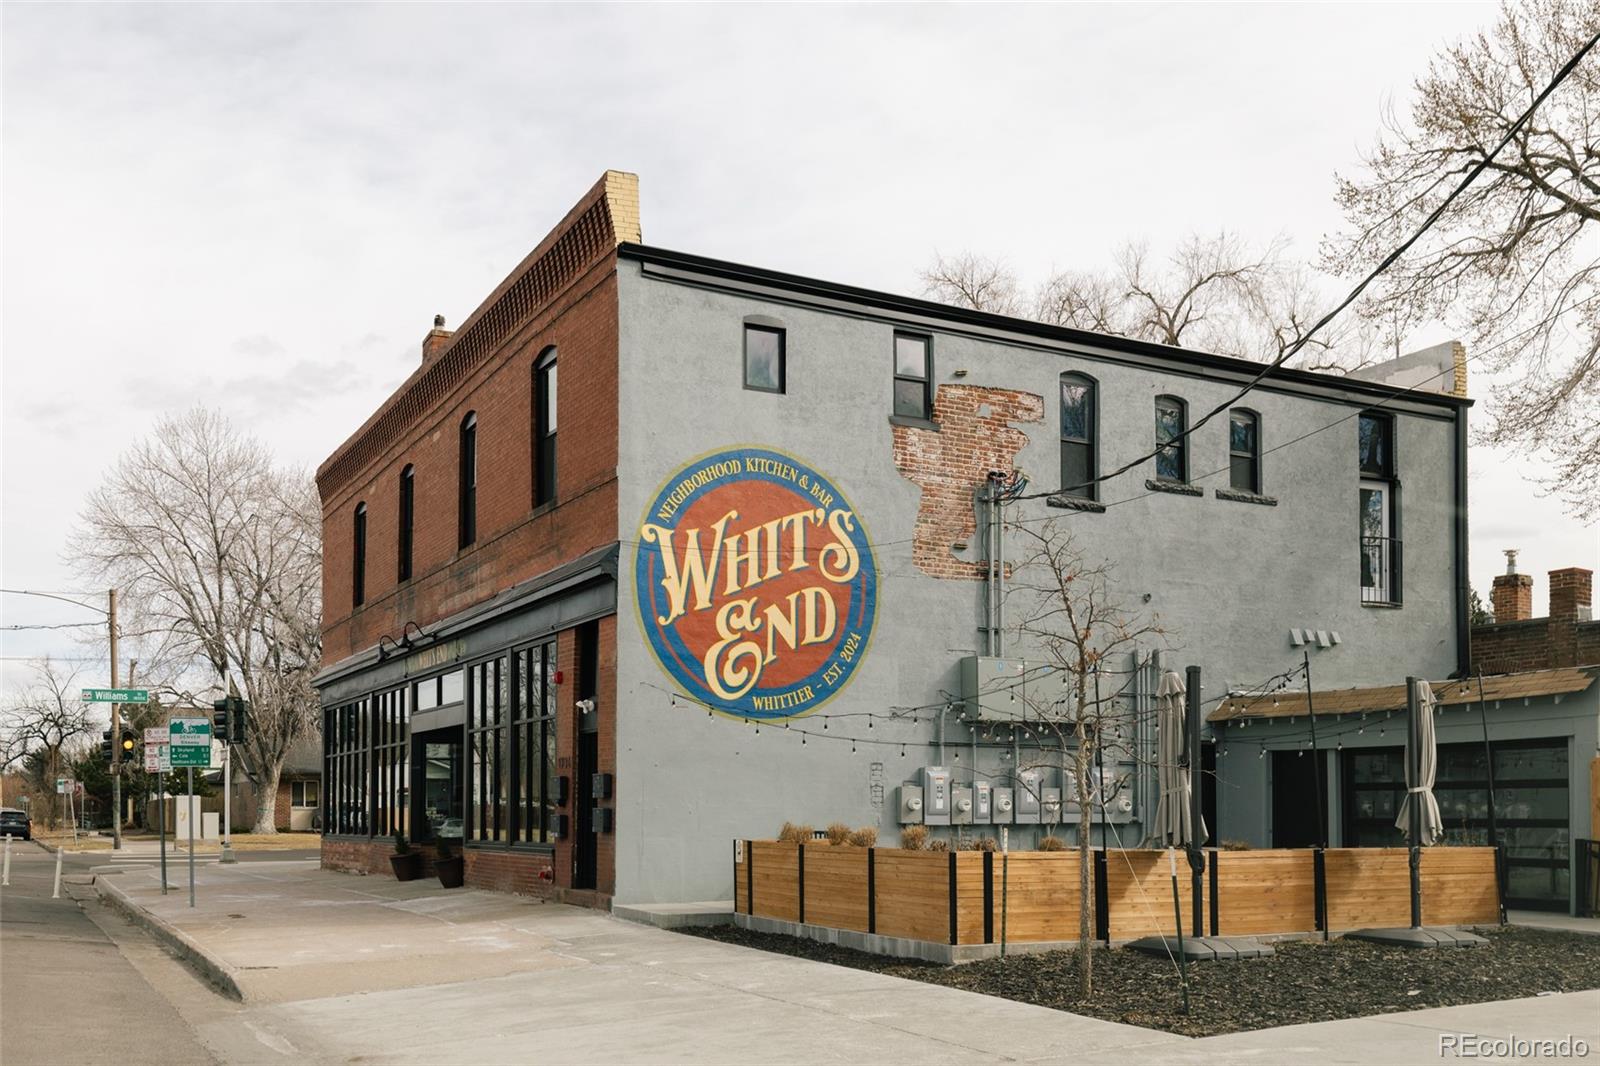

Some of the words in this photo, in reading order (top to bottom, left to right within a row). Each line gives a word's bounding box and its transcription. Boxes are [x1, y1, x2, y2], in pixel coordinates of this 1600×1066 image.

[657, 459, 742, 523] NEIGHBORHOOD
[745, 457, 799, 482] KITCHEN
[798, 474, 809, 490] &
[809, 481, 834, 508] BAR
[641, 508, 860, 626] WHIT'S
[703, 587, 837, 701] END
[752, 685, 815, 710] WHITTIER
[822, 662, 846, 686] EST.
[840, 631, 862, 663] 2024
[95, 691, 128, 700] Williams
